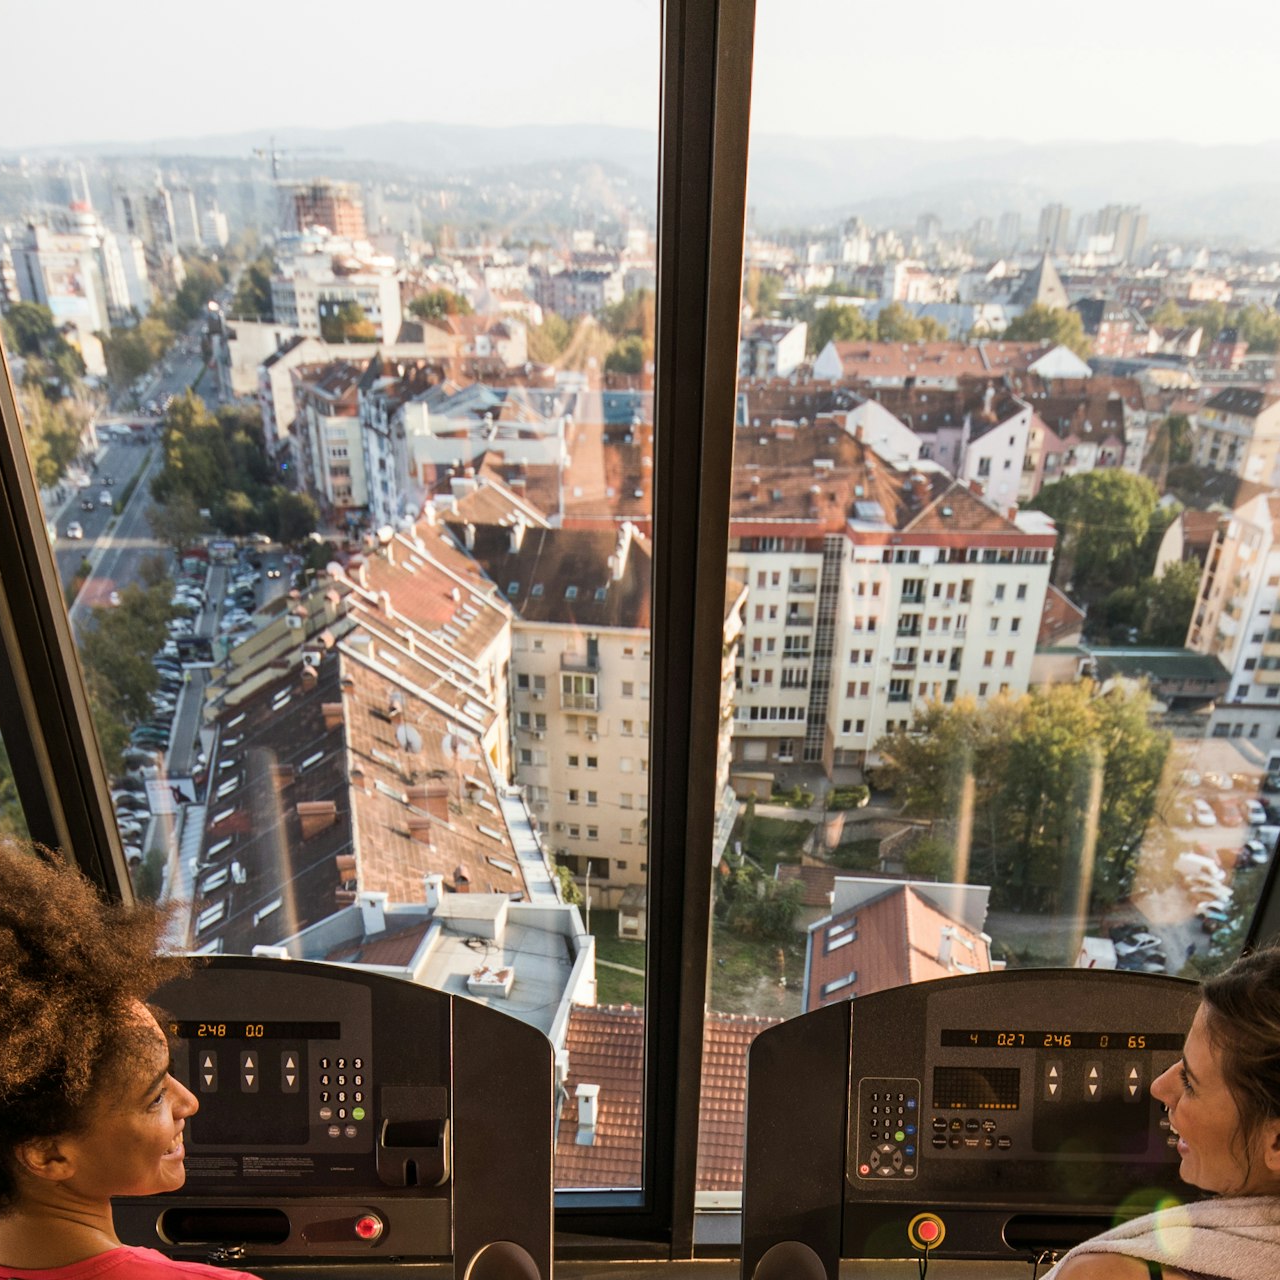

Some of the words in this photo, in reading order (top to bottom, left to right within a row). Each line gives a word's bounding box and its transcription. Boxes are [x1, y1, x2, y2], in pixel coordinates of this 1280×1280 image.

[245, 1024, 264, 1037] 0.0
[970, 1034, 978, 1044] 4
[997, 1033, 1025, 1046] 0.27
[322, 1059, 327, 1068] 1
[339, 1059, 345, 1068] 2
[355, 1059, 361, 1069] 3
[322, 1075, 328, 1085] 4
[339, 1075, 345, 1085] 5
[355, 1076, 361, 1085] 6
[323, 1092, 328, 1102] 7
[339, 1092, 345, 1102] 8
[355, 1092, 362, 1102] 9
[339, 1109, 345, 1118] 0
